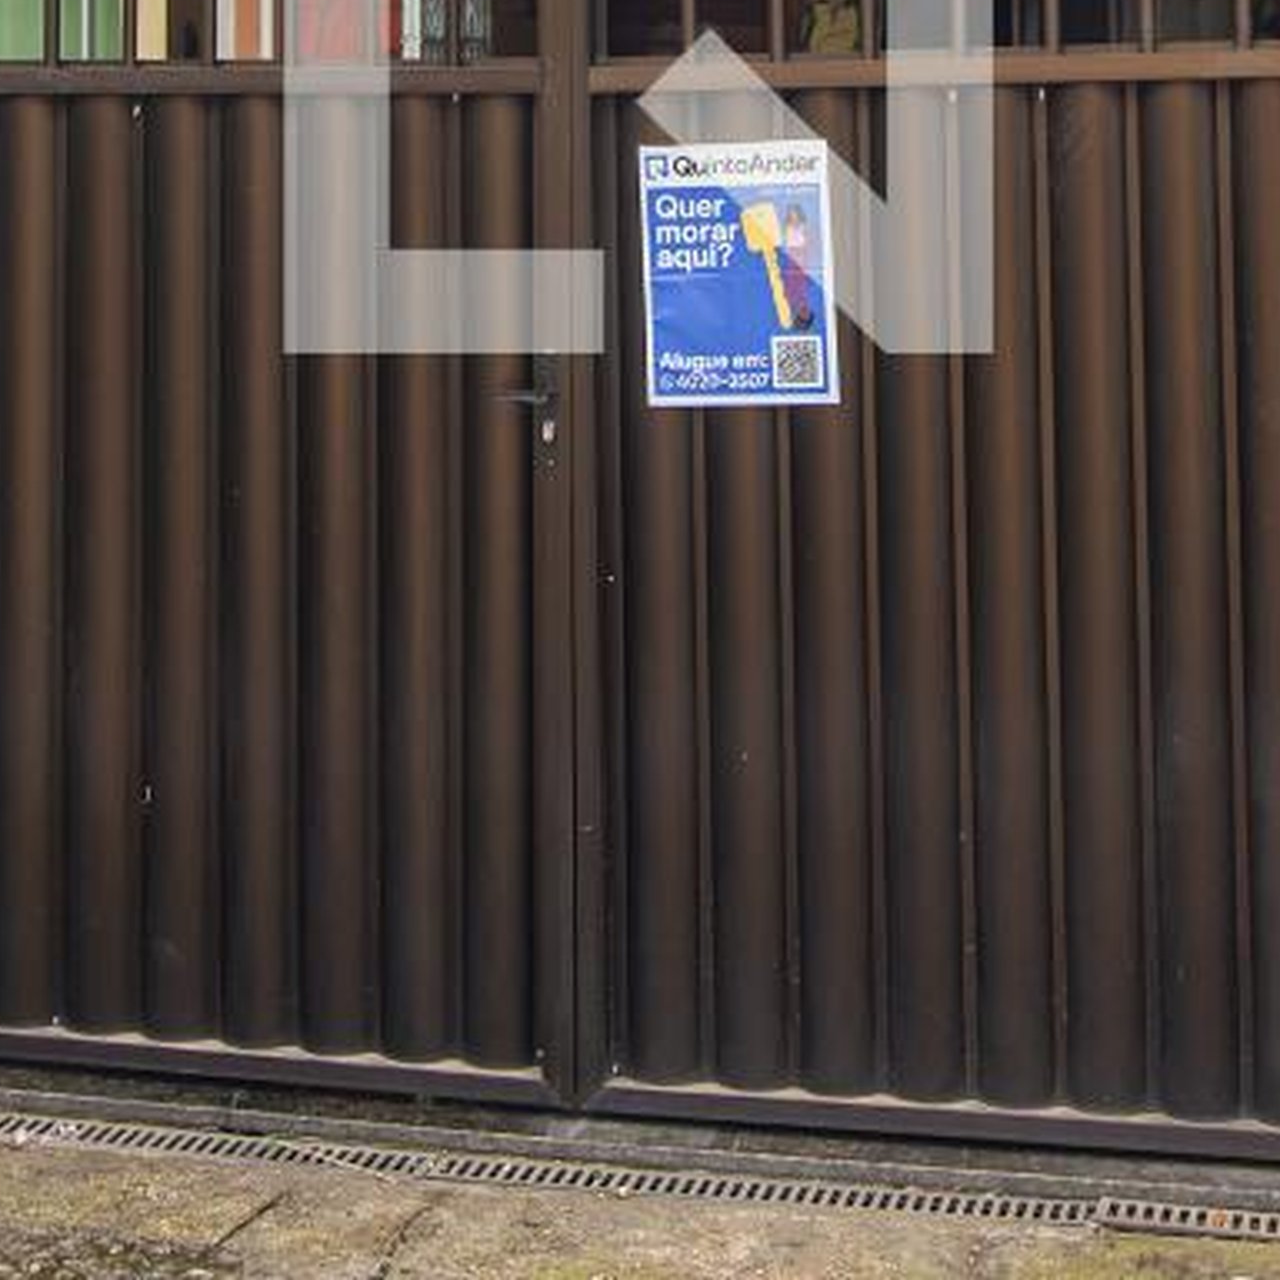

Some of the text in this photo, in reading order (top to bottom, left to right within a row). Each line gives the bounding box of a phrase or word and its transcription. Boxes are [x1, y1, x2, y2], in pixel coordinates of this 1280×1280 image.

[673, 155, 819, 177] QuintoAndar
[655, 195, 727, 219] Quer
[655, 221, 740, 244] morar
[657, 242, 734, 272] aqui?
[660, 351, 729, 372] Alugue
